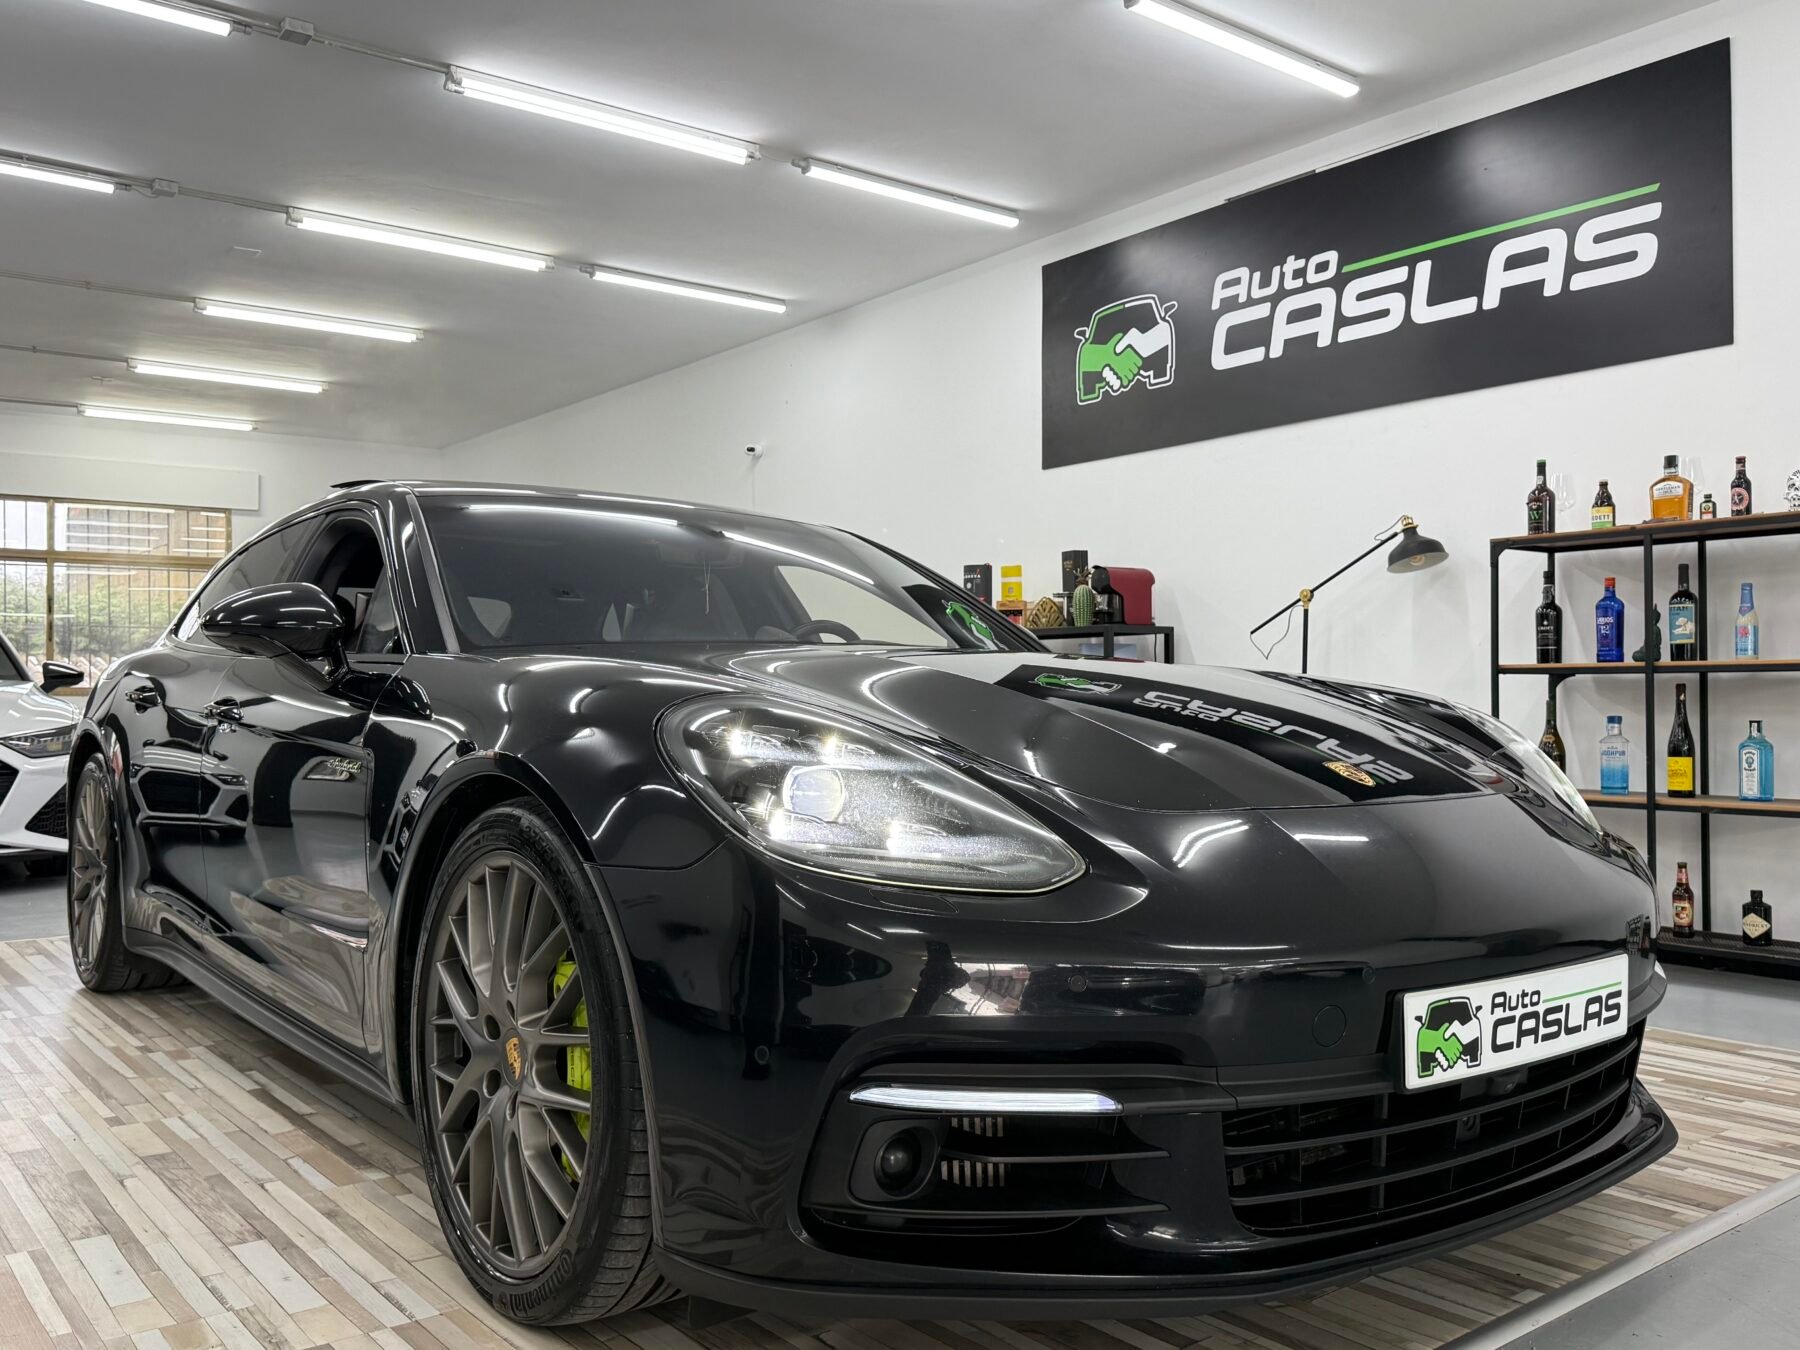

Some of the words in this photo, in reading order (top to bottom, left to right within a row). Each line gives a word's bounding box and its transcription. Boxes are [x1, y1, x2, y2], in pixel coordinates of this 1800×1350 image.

[1210, 201, 1663, 371] CASLAS
[1211, 249, 1340, 311] Auto
[1490, 988, 1541, 1016] Auto
[1490, 989, 1623, 1054] CASLAS
